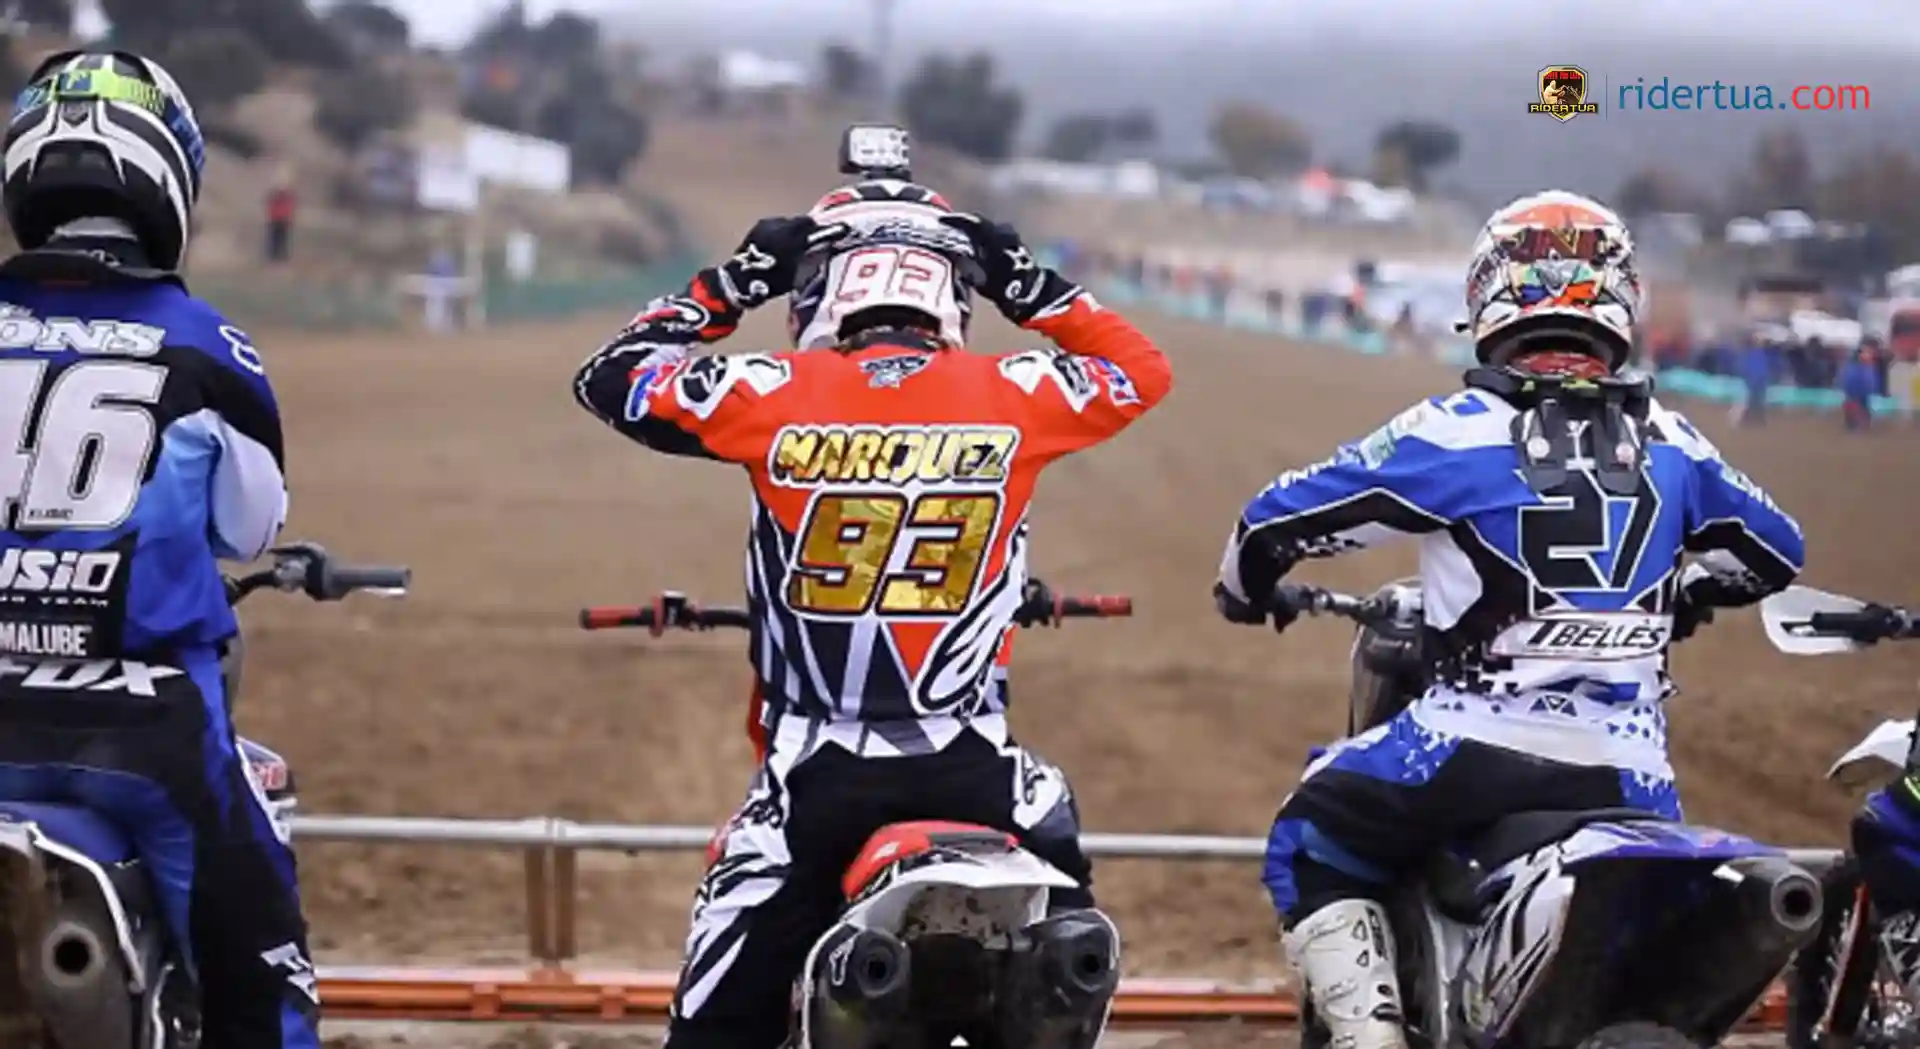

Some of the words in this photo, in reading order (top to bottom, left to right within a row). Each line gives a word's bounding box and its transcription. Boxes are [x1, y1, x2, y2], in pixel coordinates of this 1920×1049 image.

[836, 247, 949, 308] 93
[776, 428, 1018, 486] MARQUEZ
[786, 492, 1002, 616] 93
[1518, 450, 1662, 592] 27
